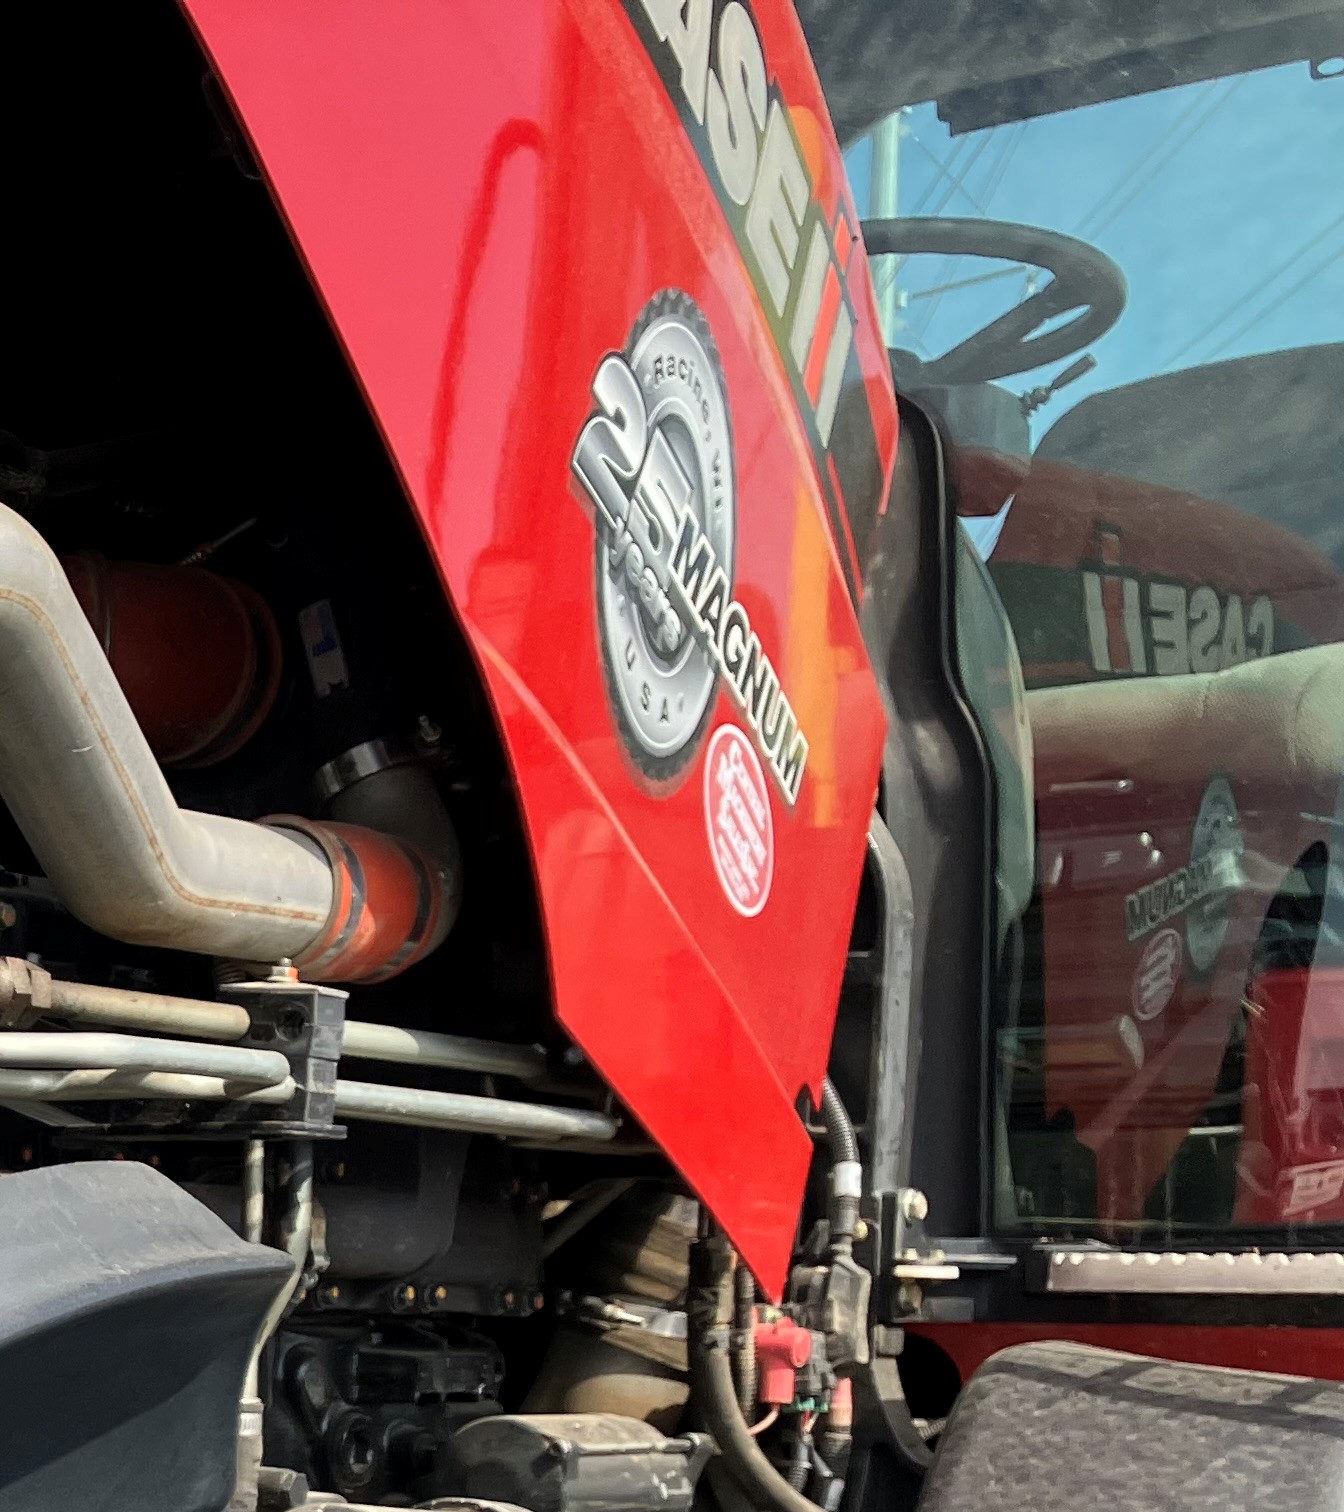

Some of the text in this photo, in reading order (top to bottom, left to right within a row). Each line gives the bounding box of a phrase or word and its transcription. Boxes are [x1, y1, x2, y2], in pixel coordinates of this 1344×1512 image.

[570, 351, 695, 591] 25
[610, 514, 682, 652] years
[667, 506, 810, 806] MAGNUM
